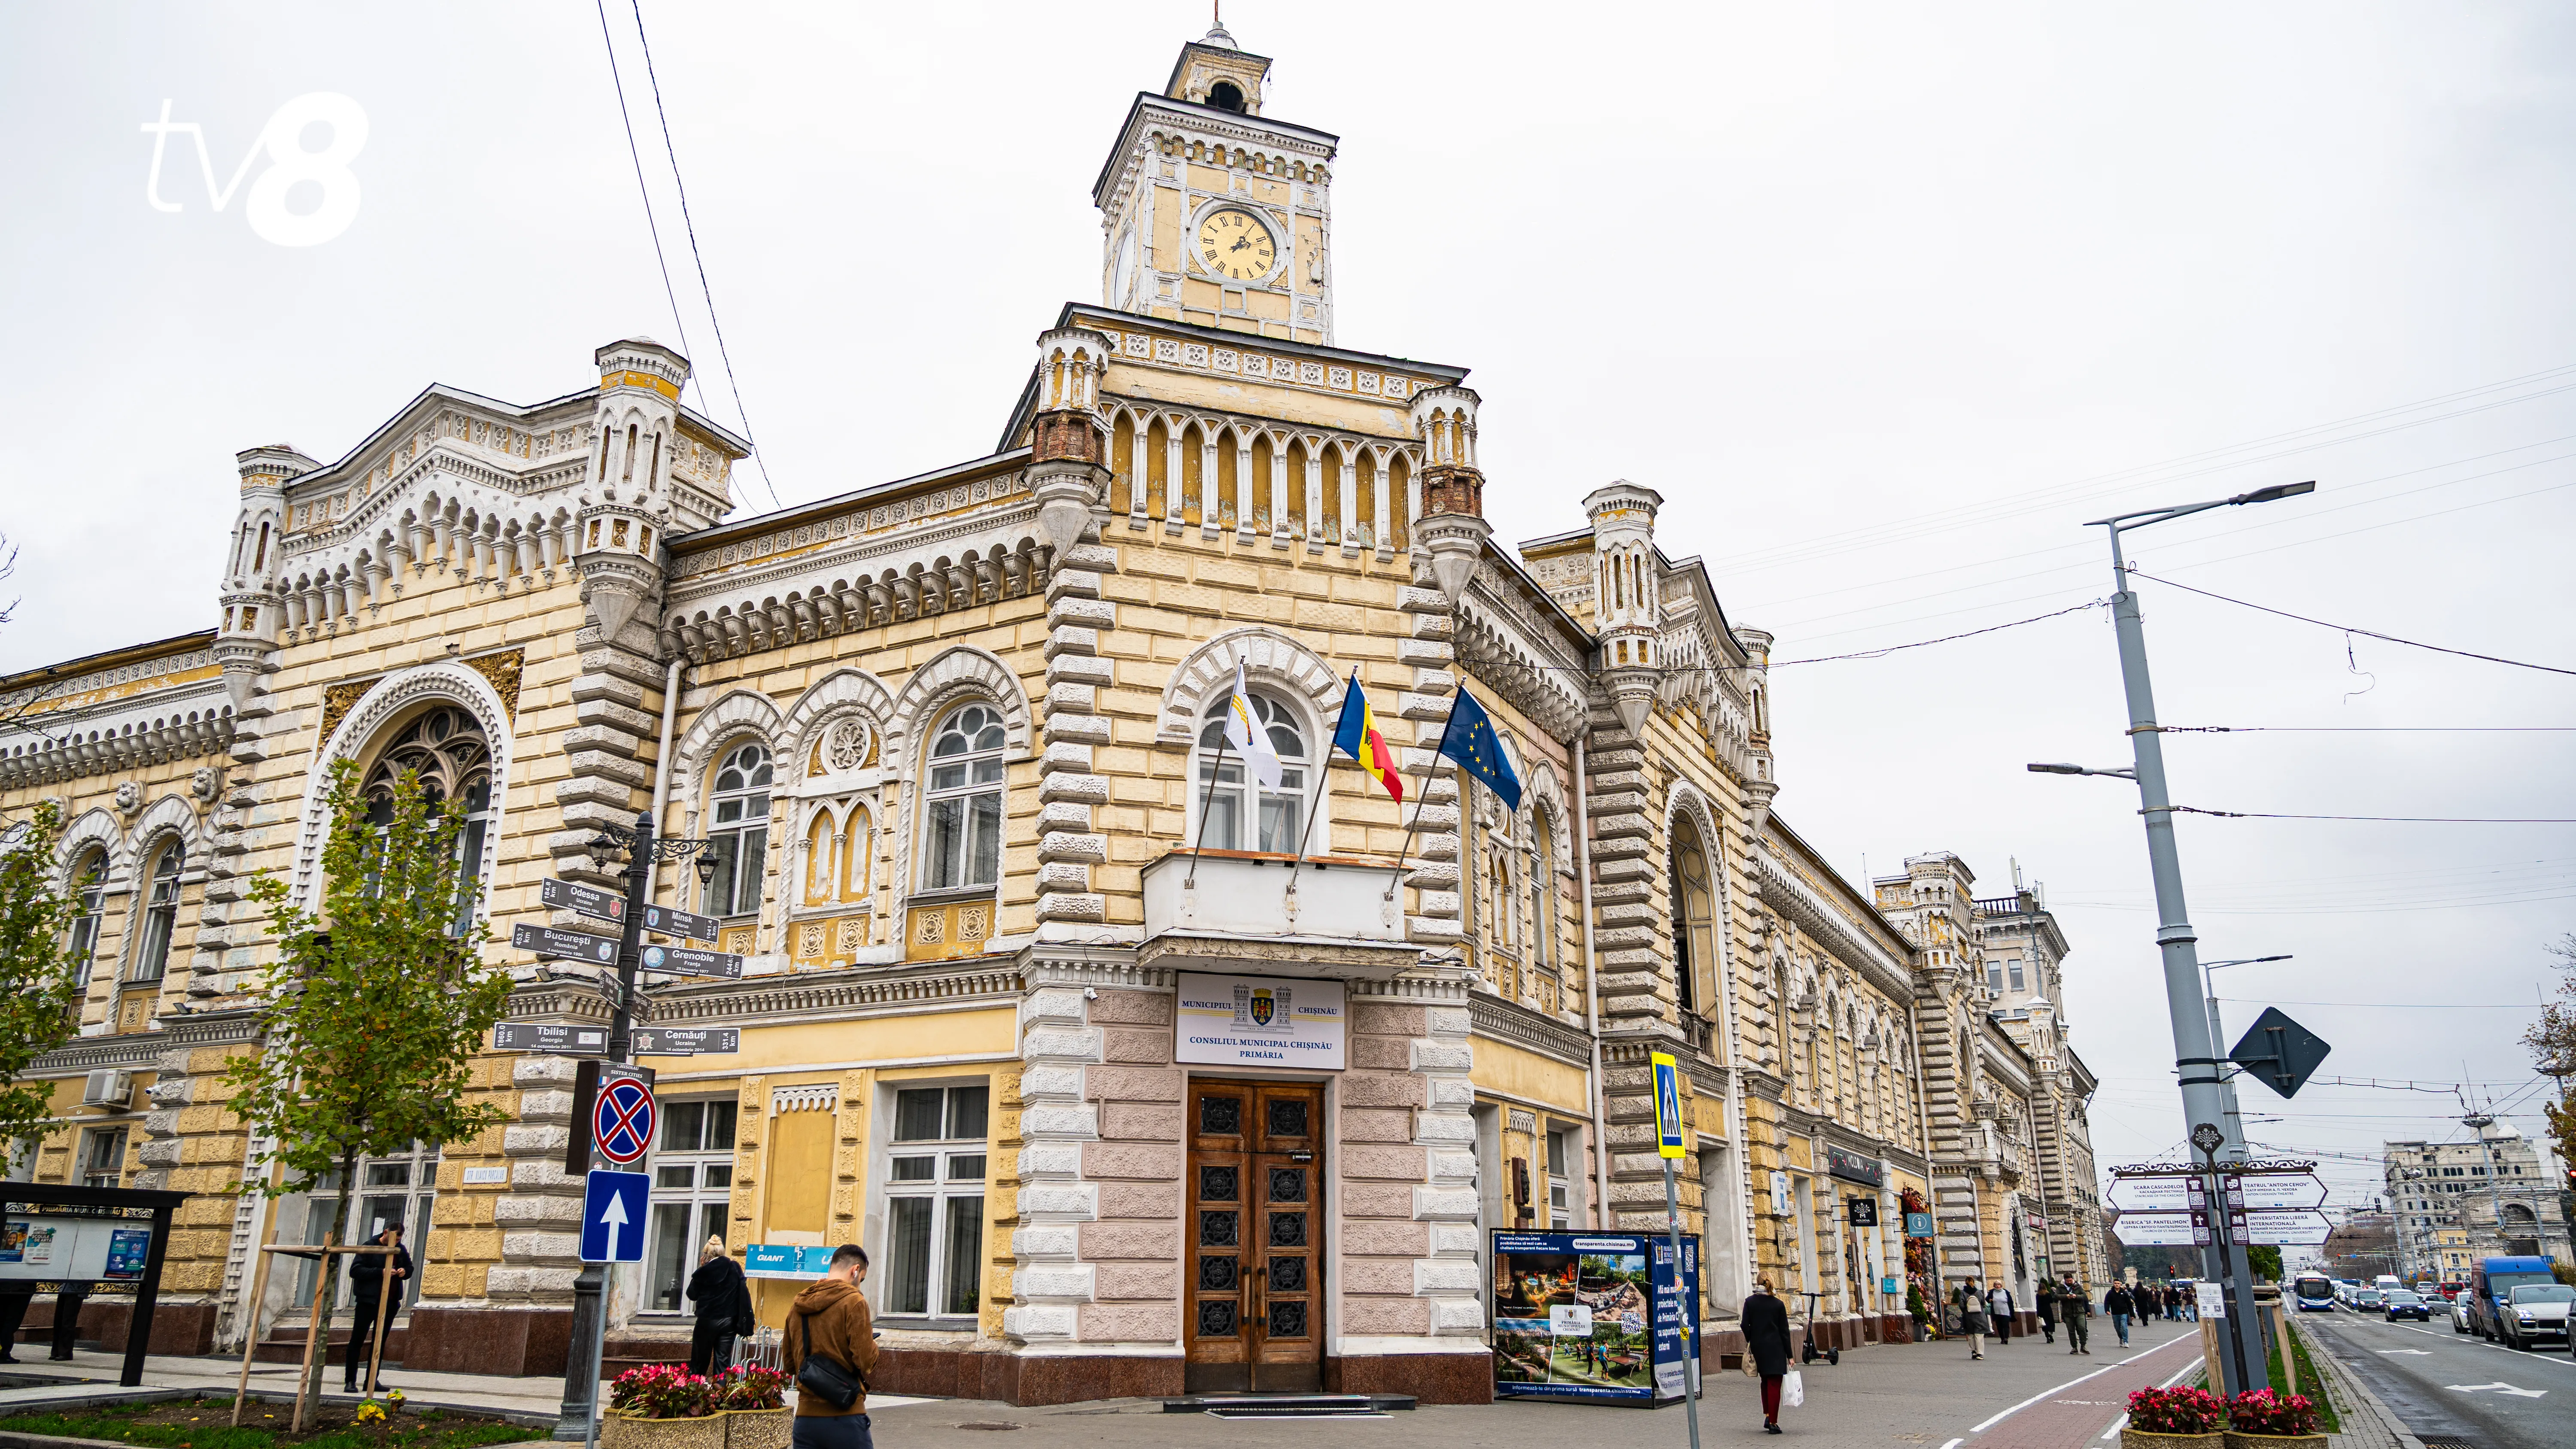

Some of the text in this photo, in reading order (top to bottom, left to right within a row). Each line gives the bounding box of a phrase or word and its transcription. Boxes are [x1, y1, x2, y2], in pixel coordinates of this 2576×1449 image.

[550, 887, 556, 897] km
[571, 887, 599, 901] Odessa
[672, 911, 693, 923] Minsk
[516, 927, 524, 945] 453.7
[711, 926, 717, 936] km
[523, 932, 531, 943] km
[544, 930, 590, 946] București
[554, 942, 578, 950] România
[672, 950, 715, 962] Grenoble
[733, 962, 740, 972] km
[1182, 1000, 1233, 1009] MUNICIPIUL
[498, 1025, 506, 1046] 1860.0
[505, 1031, 513, 1042] km
[537, 1027, 568, 1036] Tbilisi
[665, 1030, 707, 1042] Cernăuți
[729, 1036, 736, 1046] km
[1190, 1036, 1238, 1045] CONSILIUL
[1239, 1039, 1288, 1048] MUNICIPAL
[1239, 1049, 1284, 1059] PRIMĂRIA
[821, 1255, 832, 1264] Li
[1658, 1298, 1673, 1310] proiectele
[1658, 1313, 1662, 1322] de
[1662, 1326, 1676, 1338] suportul
[1659, 1341, 1670, 1351] externi
